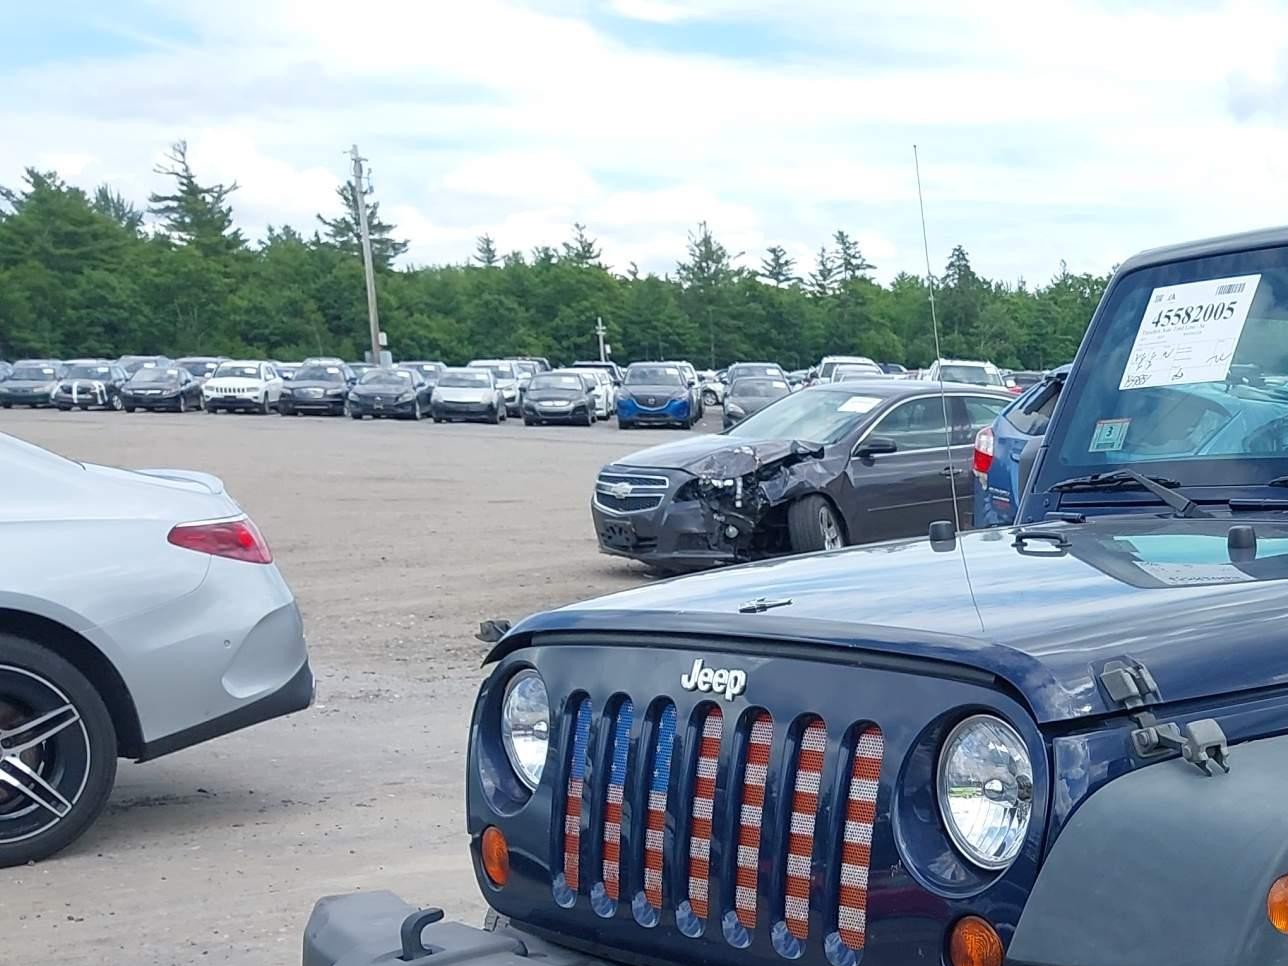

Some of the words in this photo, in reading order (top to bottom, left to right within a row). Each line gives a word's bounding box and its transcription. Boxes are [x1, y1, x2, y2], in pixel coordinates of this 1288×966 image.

[1152, 300, 1239, 328] 45582005
[1105, 426, 1114, 437] 3
[680, 658, 746, 701] Jeep
